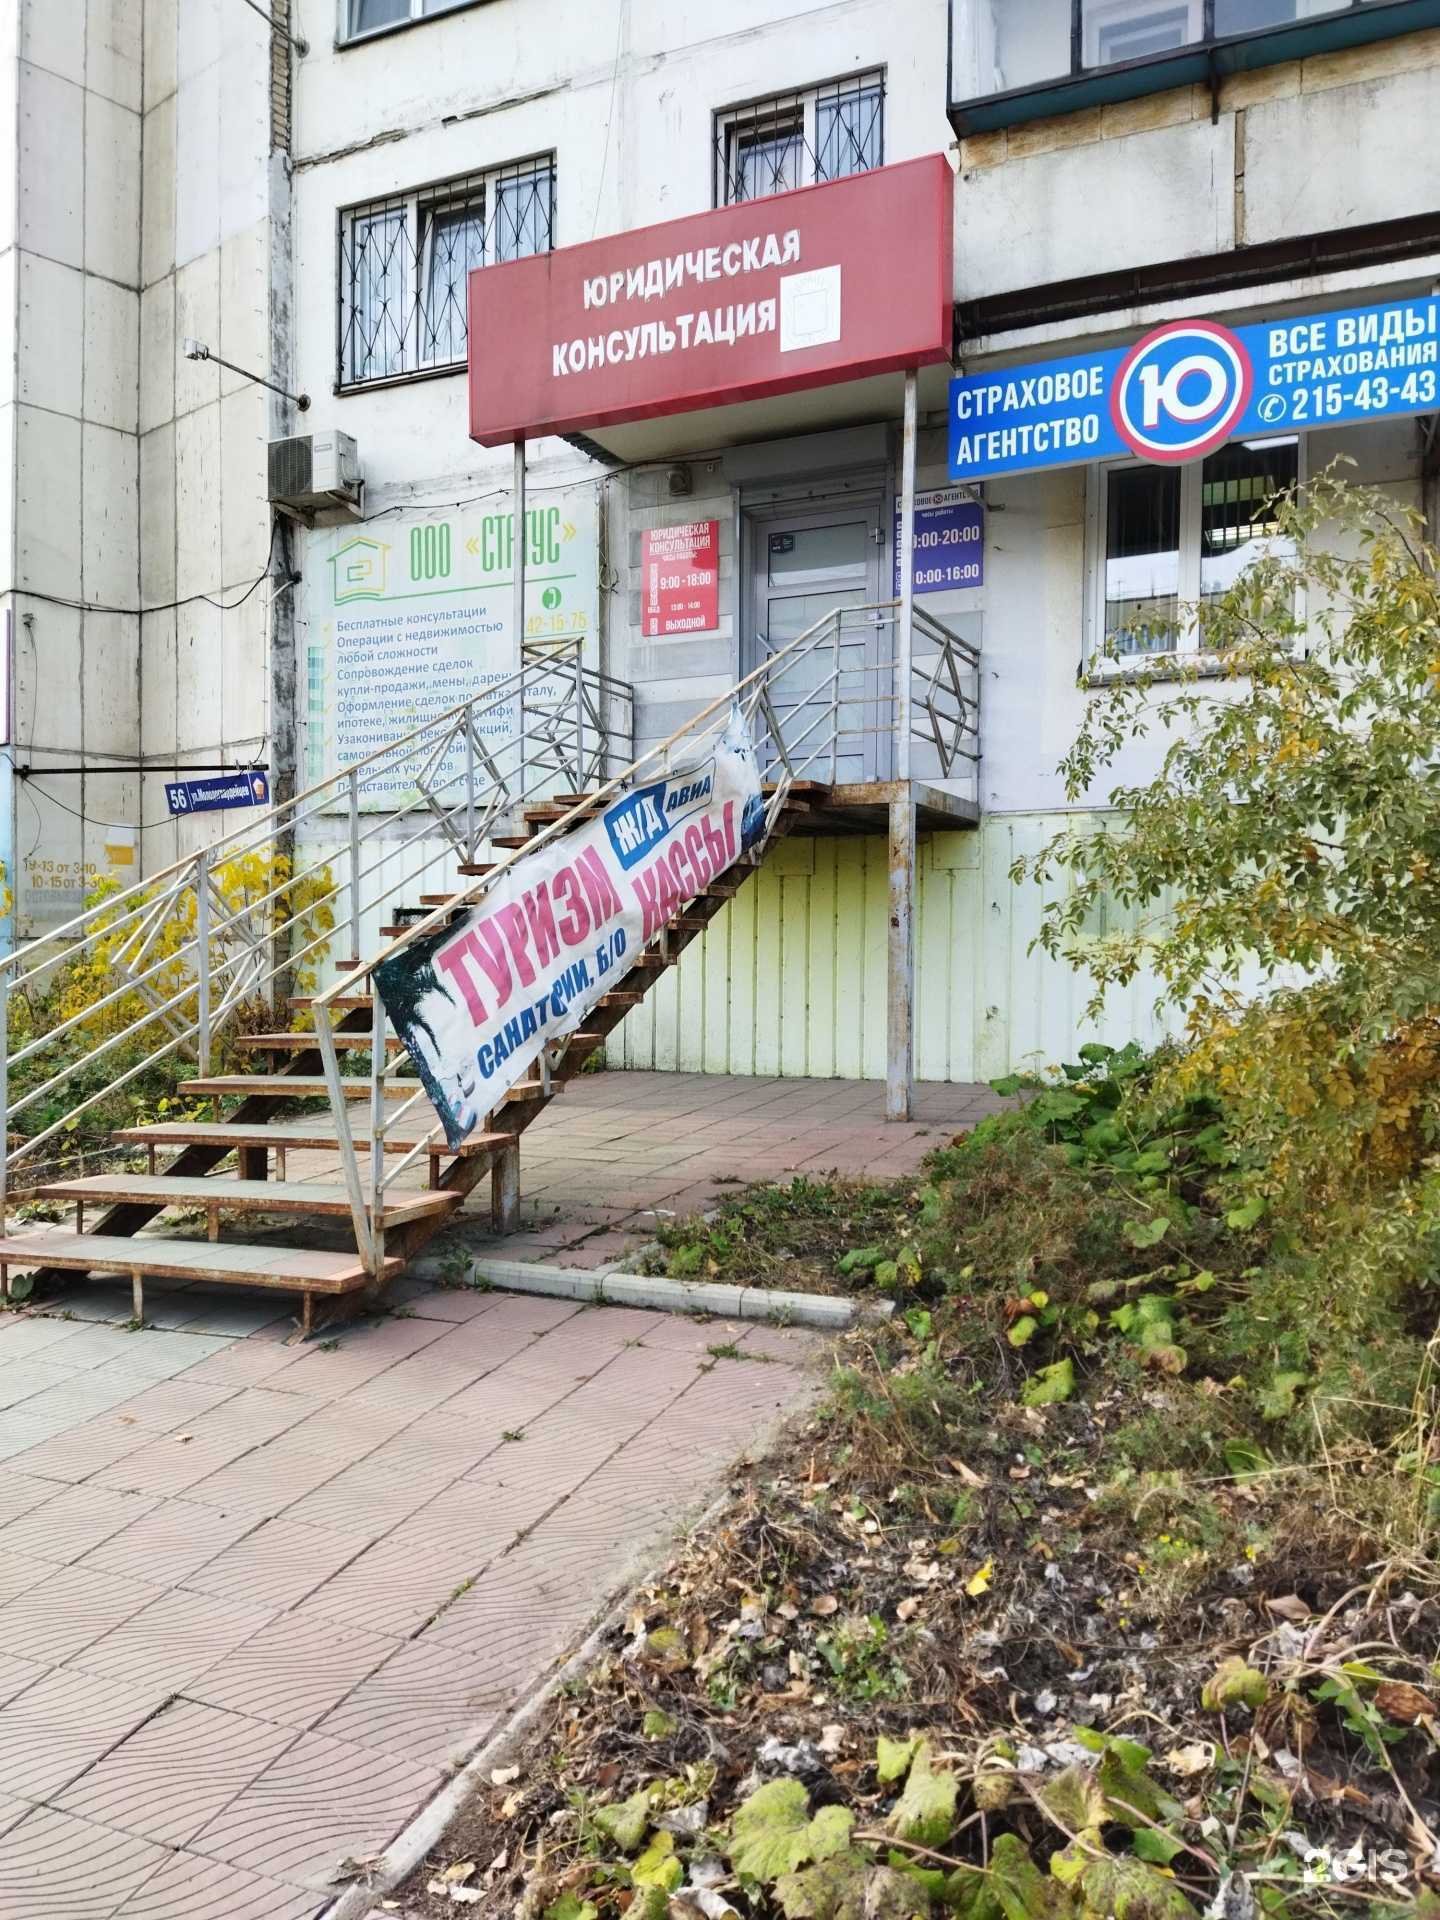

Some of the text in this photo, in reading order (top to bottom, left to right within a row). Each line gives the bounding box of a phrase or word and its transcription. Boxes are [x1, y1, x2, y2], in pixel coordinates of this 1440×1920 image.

[584, 229, 801, 309] ЮРИДИЧЕСКАЯ
[552, 298, 777, 377] КОНСУЛЬТАЦИЯ
[1268, 304, 1437, 359] ВСЕ ВИДЫ
[1268, 341, 1438, 387] СТРАХОВАНИЯ
[957, 366, 1103, 420] СТРАХОВОЕ
[1292, 370, 1436, 421] 215-43-43
[957, 414, 1099, 466] АГЕНТСТВО
[649, 535, 711, 553] КОНСУЛЬТАЦИЯ
[651, 522, 709, 541] ЮРИДИЧЕСКАЯ
[410, 522, 450, 582] ООО
[337, 607, 487, 632] Бесплатные консультации
[665, 614, 706, 631] ВЫХОДНОЙ
[337, 622, 503, 648] Операции с недвижимостью
[337, 646, 438, 664] любой сложности
[337, 659, 473, 681] Сопровождение сделок
[337, 697, 411, 713] Оформление
[415, 694, 455, 707] сделок
[459, 692, 472, 703] по
[337, 717, 385, 729] ипотеке,
[459, 776, 485, 787] сде
[169, 788, 187, 809] 56
[613, 775, 711, 857] Ж/Д АВИА
[57, 863, 71, 873] от
[630, 800, 735, 944] КАССЫ
[63, 878, 77, 889] от
[437, 844, 624, 1028] ТУРИЗМ
[596, 928, 627, 977] Б/О
